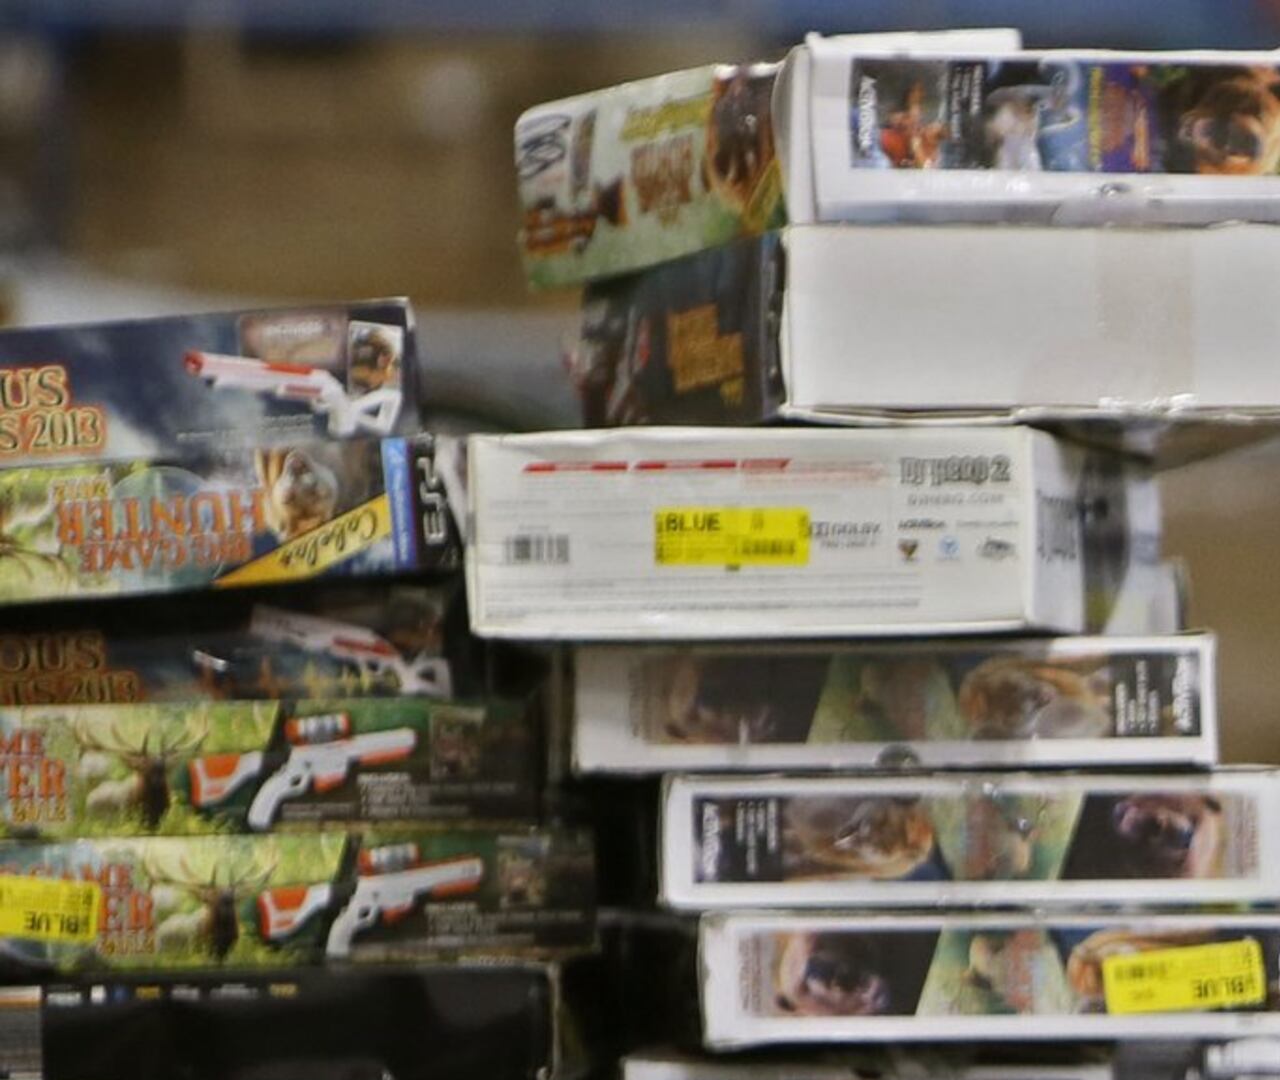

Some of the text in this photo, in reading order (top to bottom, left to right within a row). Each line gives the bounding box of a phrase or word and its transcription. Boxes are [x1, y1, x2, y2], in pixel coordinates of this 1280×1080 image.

[30, 406, 102, 449] 2013
[54, 488, 267, 547] HUNTER
[665, 512, 721, 533] BLUE
[24, 910, 80, 935] BLUE
[1193, 978, 1245, 999] BLUE
